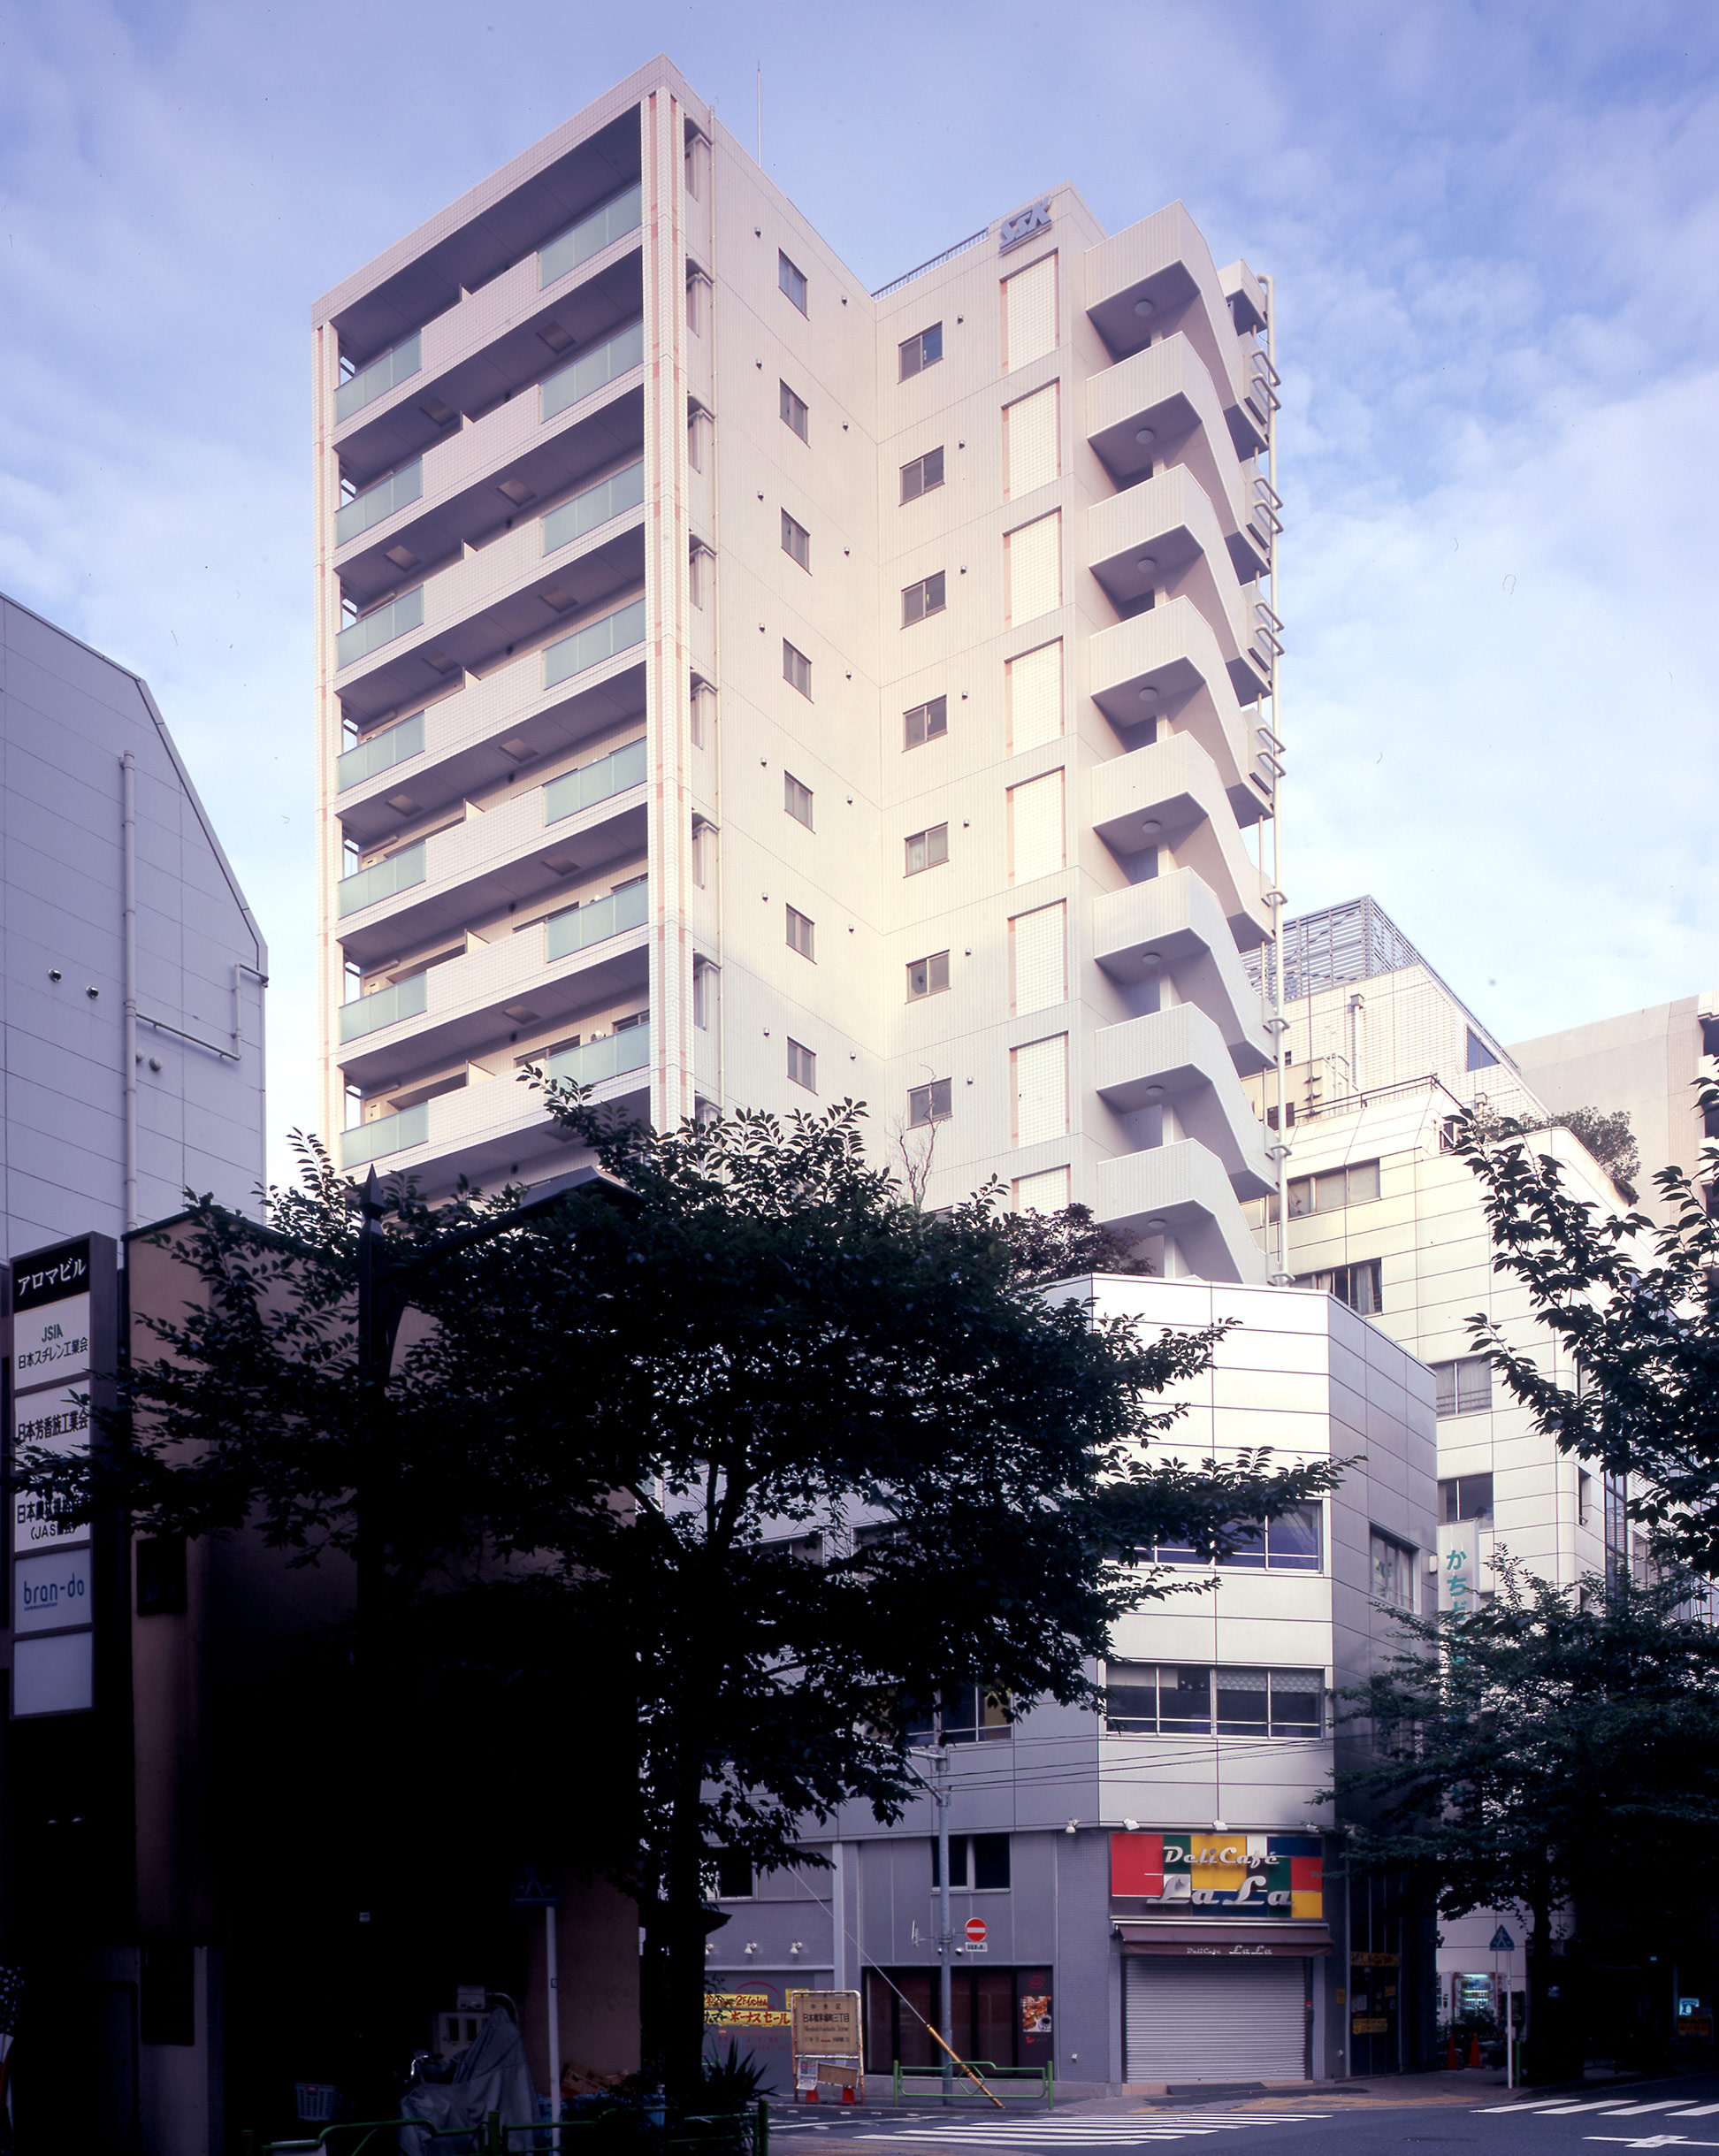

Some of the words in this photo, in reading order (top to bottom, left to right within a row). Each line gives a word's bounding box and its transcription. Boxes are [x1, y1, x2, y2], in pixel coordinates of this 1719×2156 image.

[18, 1258, 86, 1296] アロマビル
[42, 1323, 64, 1342] JSIA
[19, 1336, 88, 1369] 日本スチレン工業会
[19, 1408, 88, 1442] 日本芳香族工業会
[24, 1572, 85, 1604] bran-do
